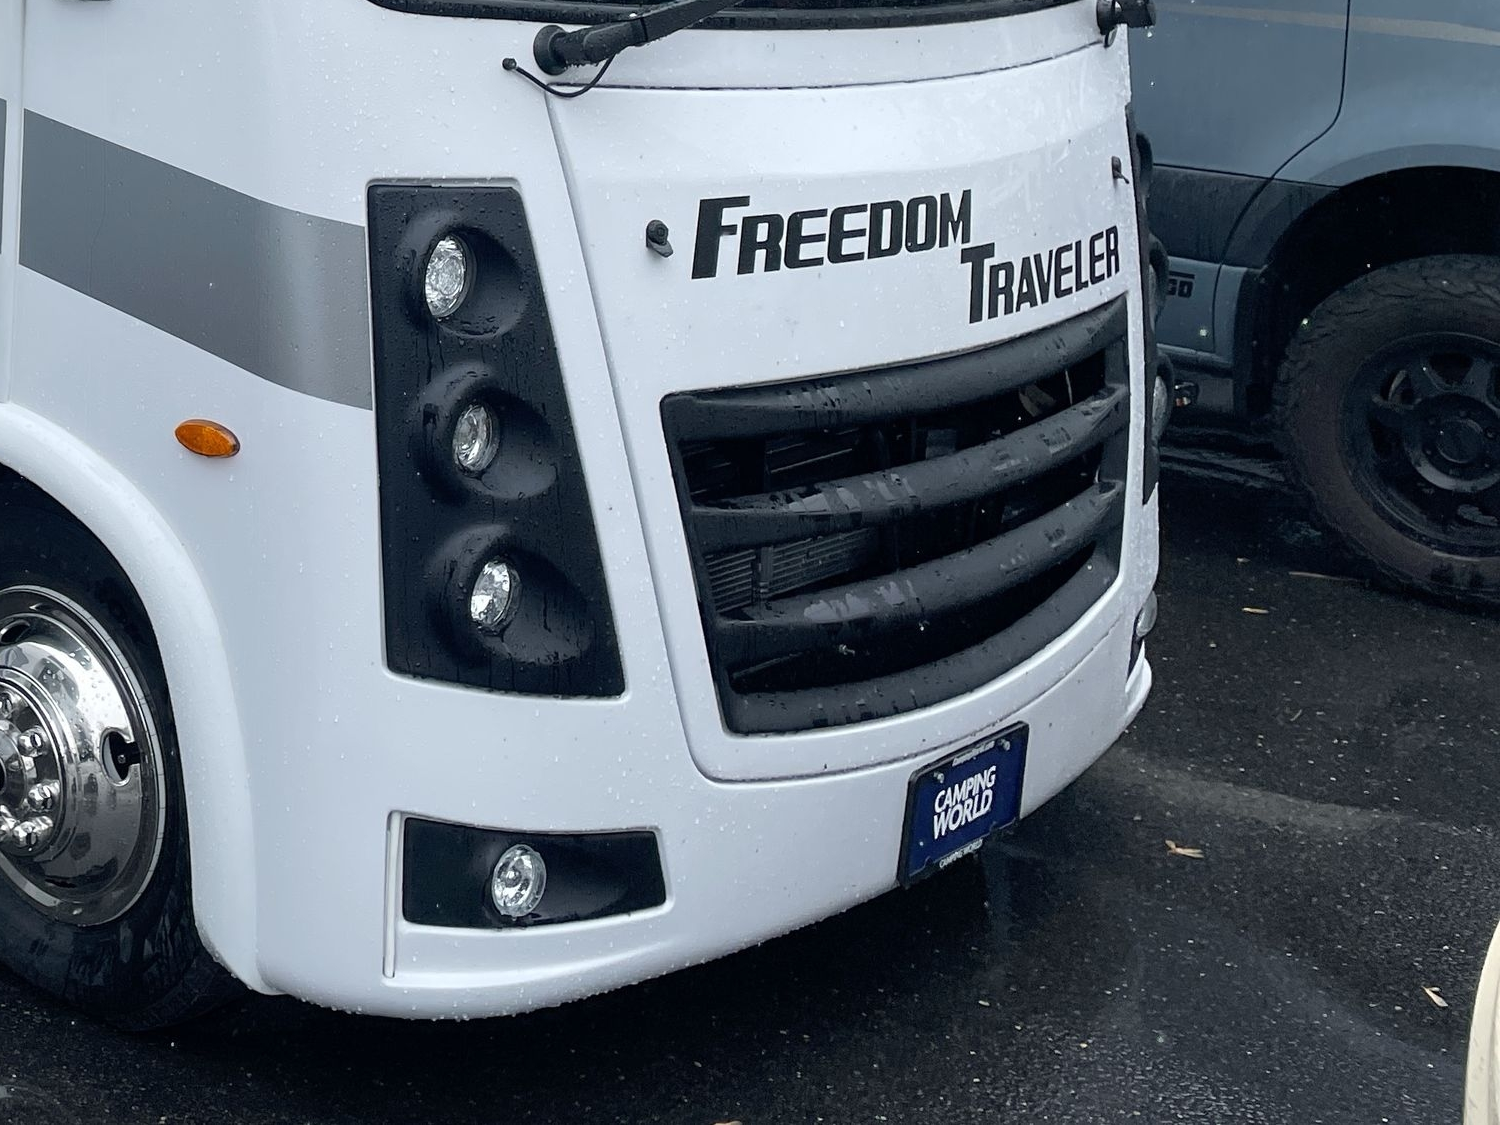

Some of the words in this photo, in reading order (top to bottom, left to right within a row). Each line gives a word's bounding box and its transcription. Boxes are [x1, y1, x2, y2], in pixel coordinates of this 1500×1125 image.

[690, 188, 973, 280] FREEDOM
[959, 224, 1121, 325] TRAVELER
[933, 765, 997, 814] CAMPING
[933, 789, 993, 840] WORLD
